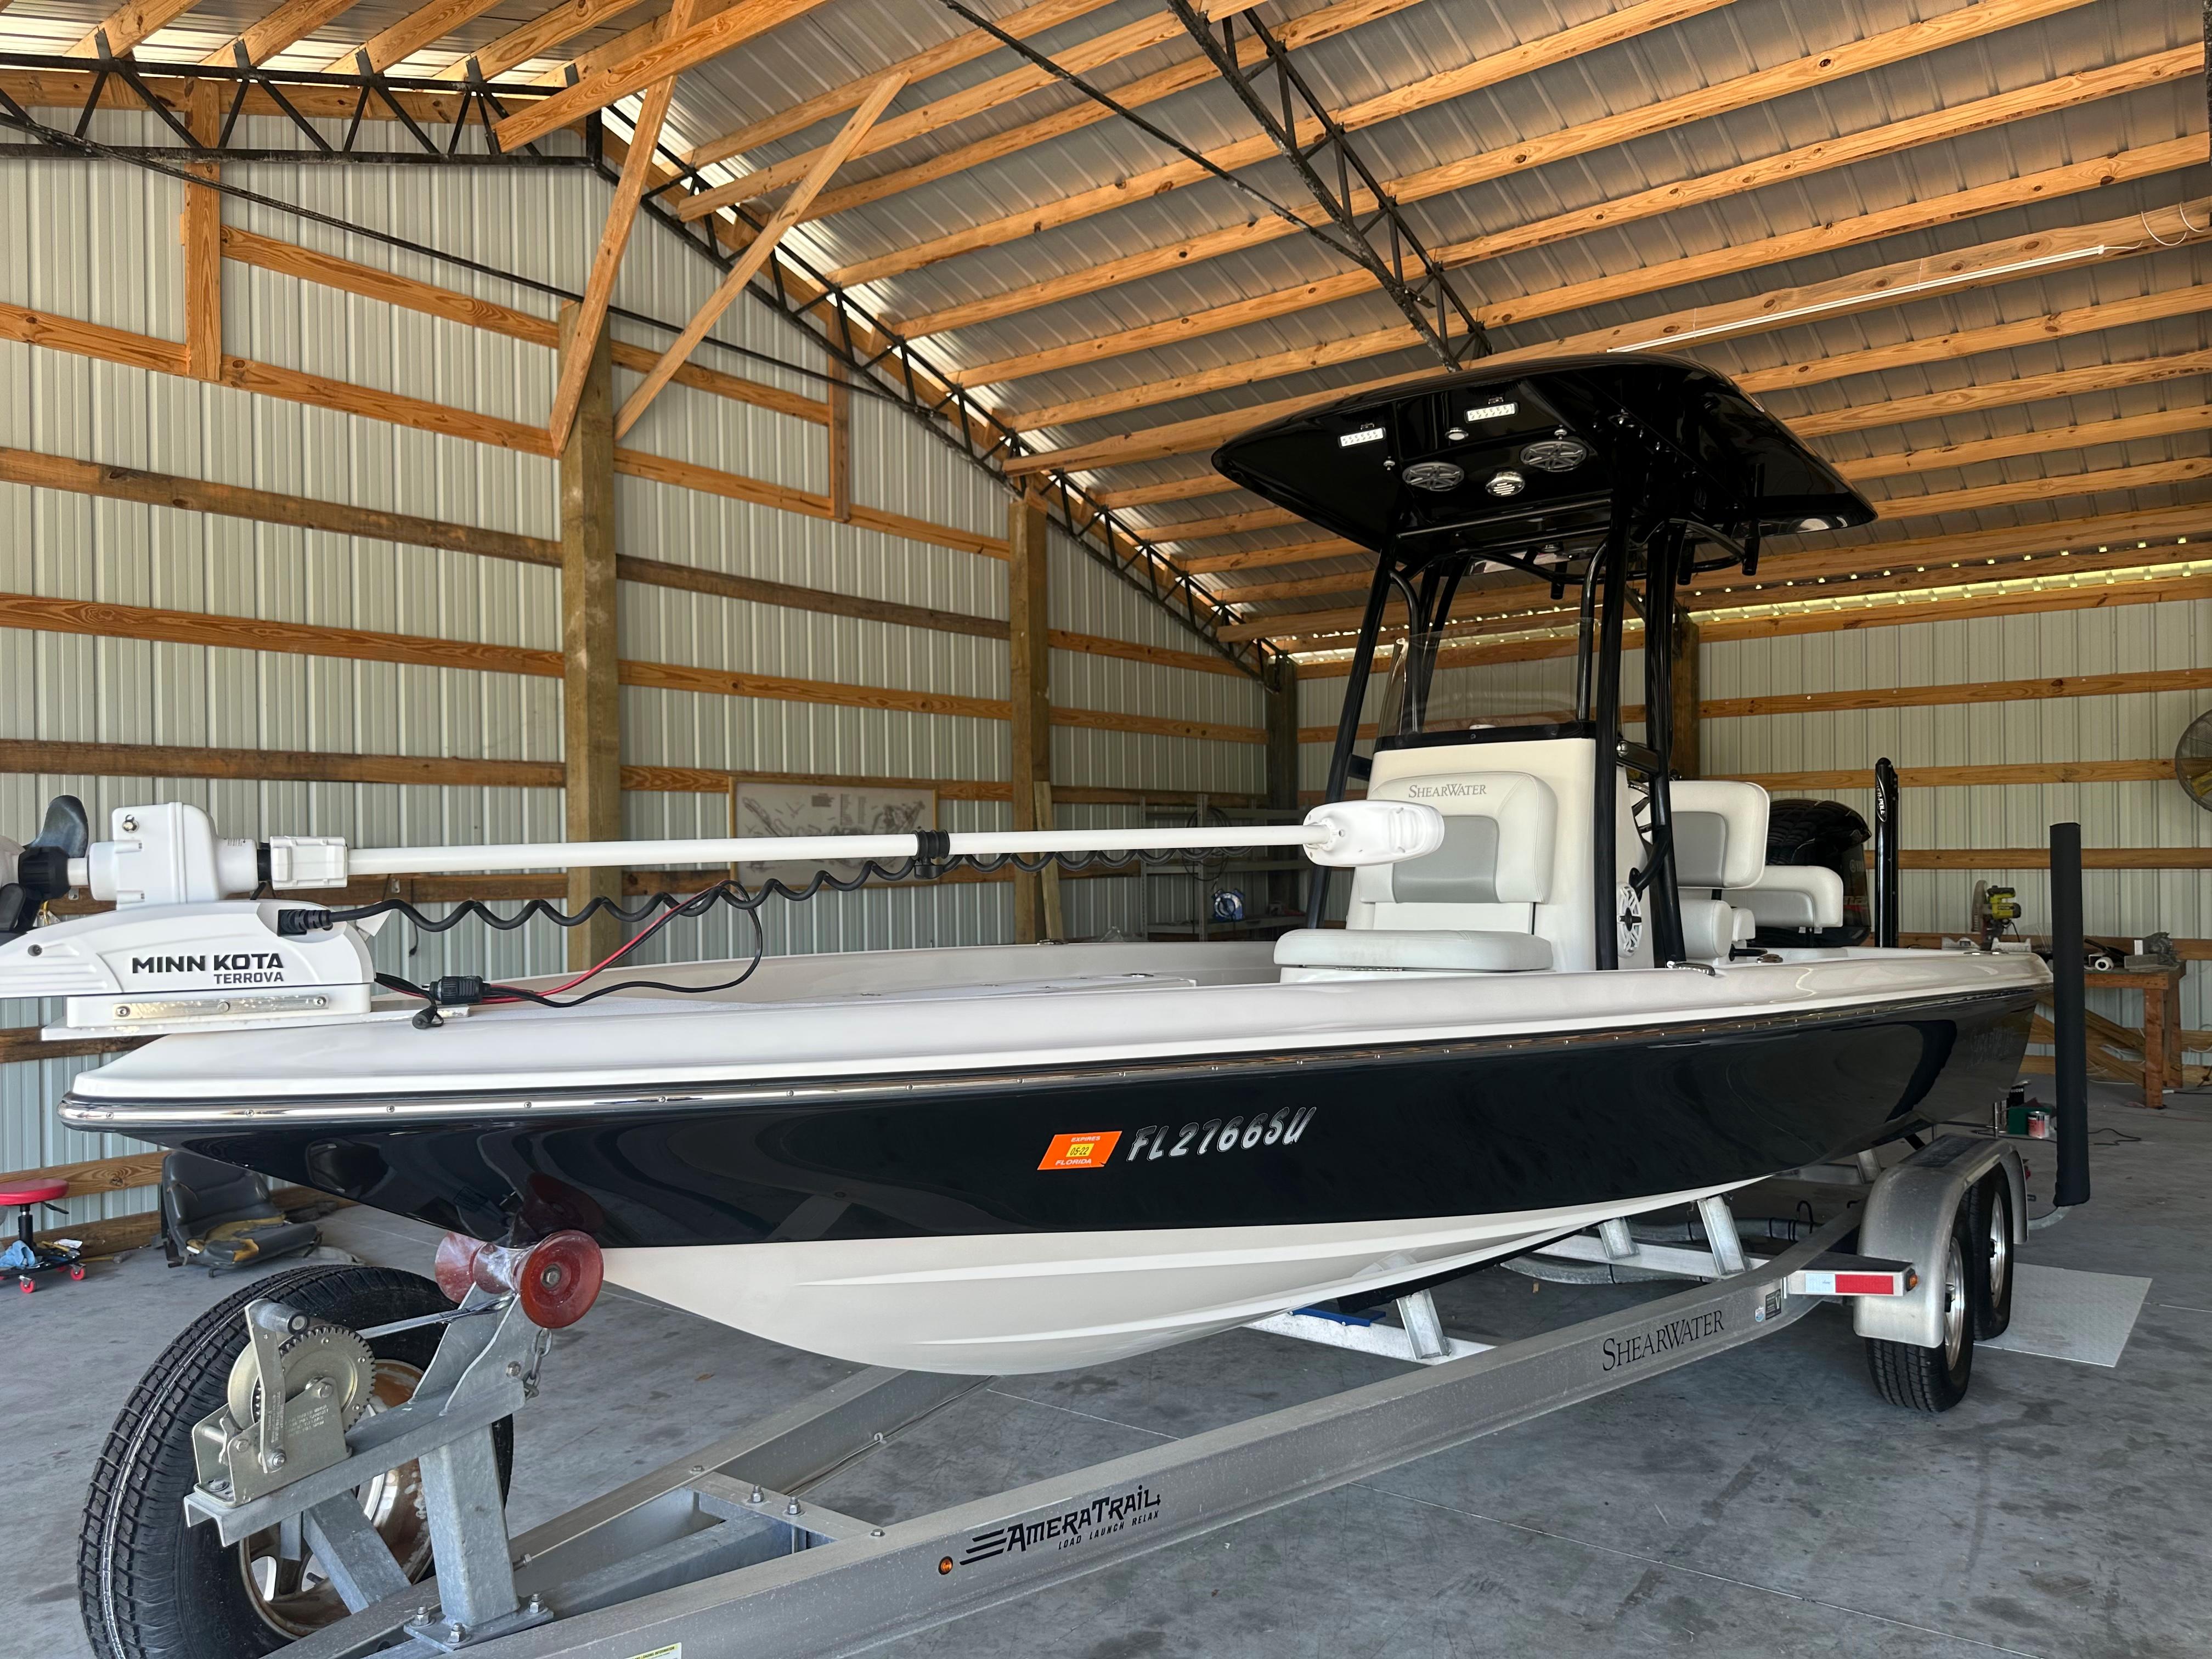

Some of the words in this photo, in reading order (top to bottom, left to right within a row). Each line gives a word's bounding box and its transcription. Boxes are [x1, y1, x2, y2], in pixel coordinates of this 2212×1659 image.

[132, 955, 206, 973] MINN
[213, 953, 284, 970] KOTA
[213, 972, 284, 985] TERROVA
[1070, 1146, 1090, 1156] 05-22
[1056, 1158, 1092, 1166] FLORIDA
[1058, 1535, 1082, 1550] LOAD
[1089, 1521, 1125, 1540] LAUNCH
[1131, 1510, 1159, 1526] RELAX
